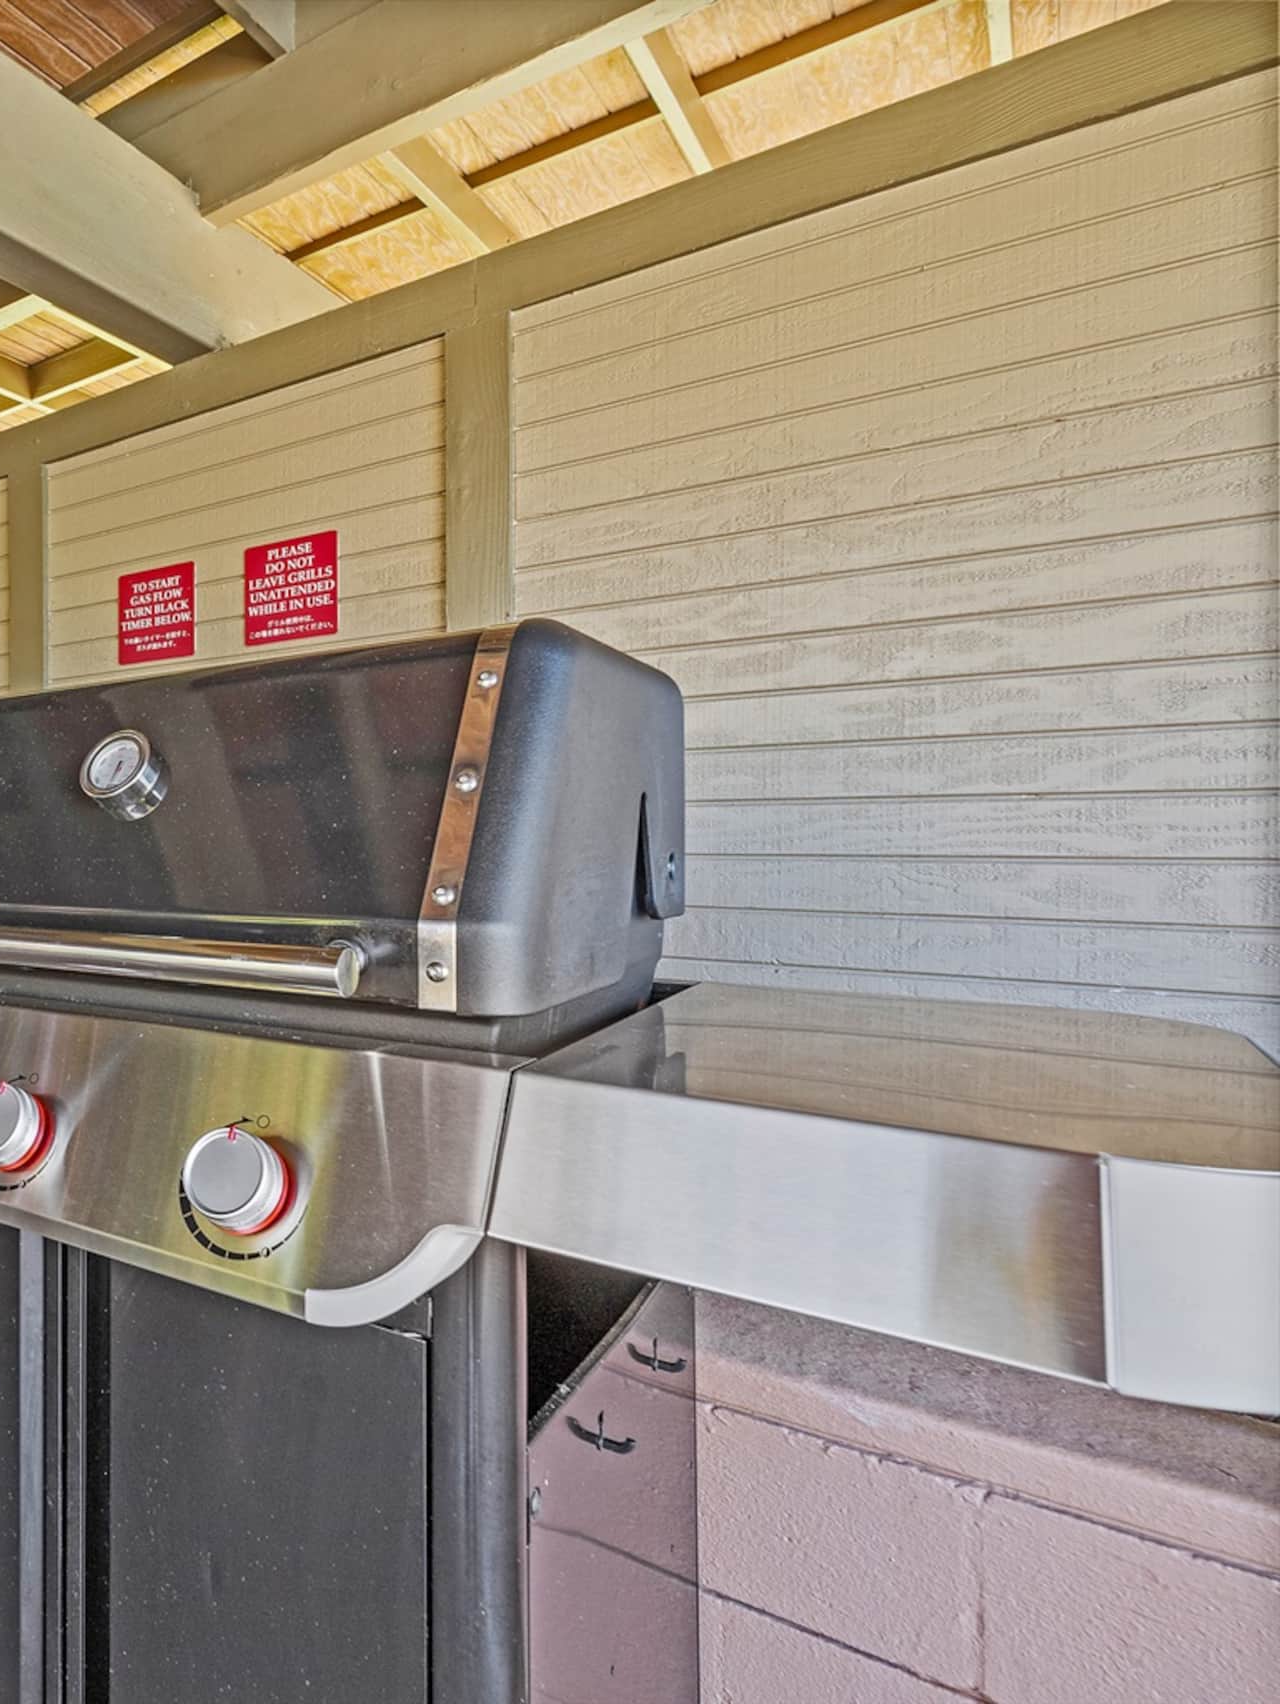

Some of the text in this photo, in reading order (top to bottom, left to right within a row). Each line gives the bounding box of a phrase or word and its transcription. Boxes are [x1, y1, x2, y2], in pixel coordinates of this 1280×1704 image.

[267, 541, 313, 561] PLEASE
[265, 555, 315, 575] DO NOT
[131, 575, 181, 594] TO START
[248, 565, 333, 591] LEAVE GRILLS
[129, 587, 183, 606] GAS FLOW
[250, 579, 335, 604] UNATTENDED
[124, 599, 190, 619] TURN BLACK
[248, 593, 334, 617] WHILE IN USE.
[121, 611, 192, 632] TIMER BELOW.
